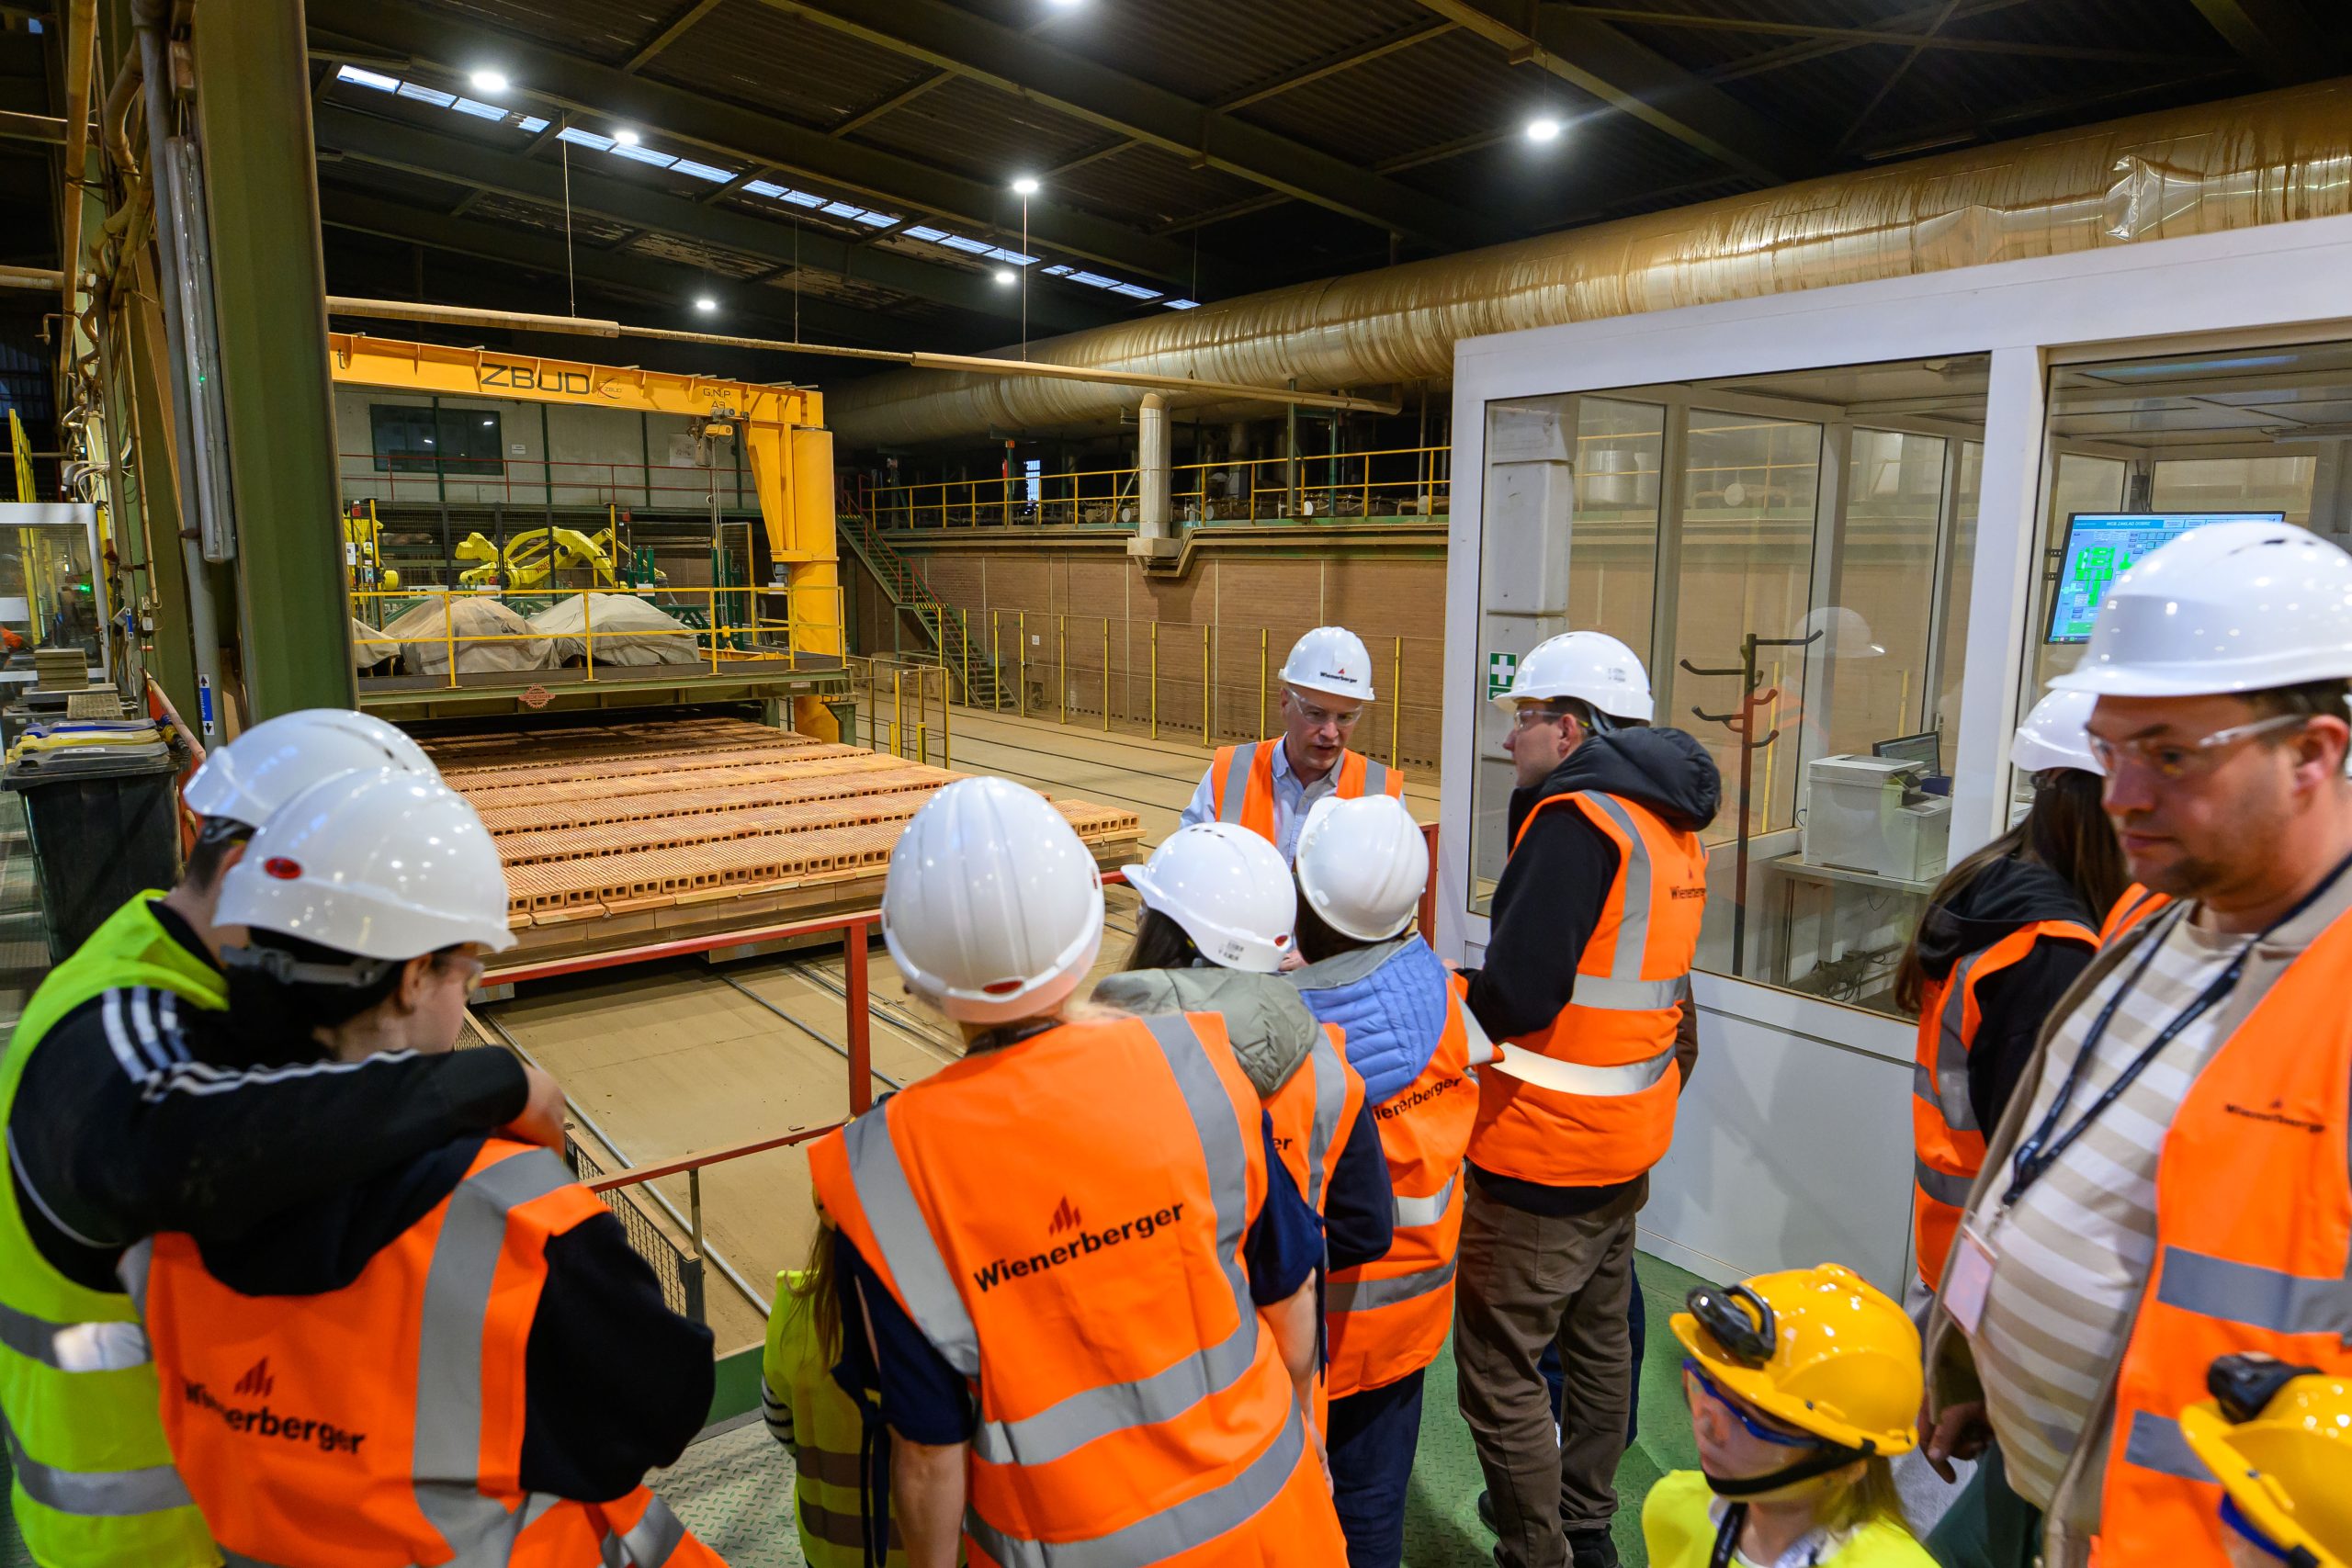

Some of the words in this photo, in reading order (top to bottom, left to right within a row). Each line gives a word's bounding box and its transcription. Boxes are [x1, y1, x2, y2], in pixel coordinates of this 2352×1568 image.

[481, 363, 590, 395] ZBUD
[703, 388, 732, 399] G.N.P.
[1320, 671, 1358, 683] Wienerberger
[974, 1202, 1183, 1292] Wienerberger
